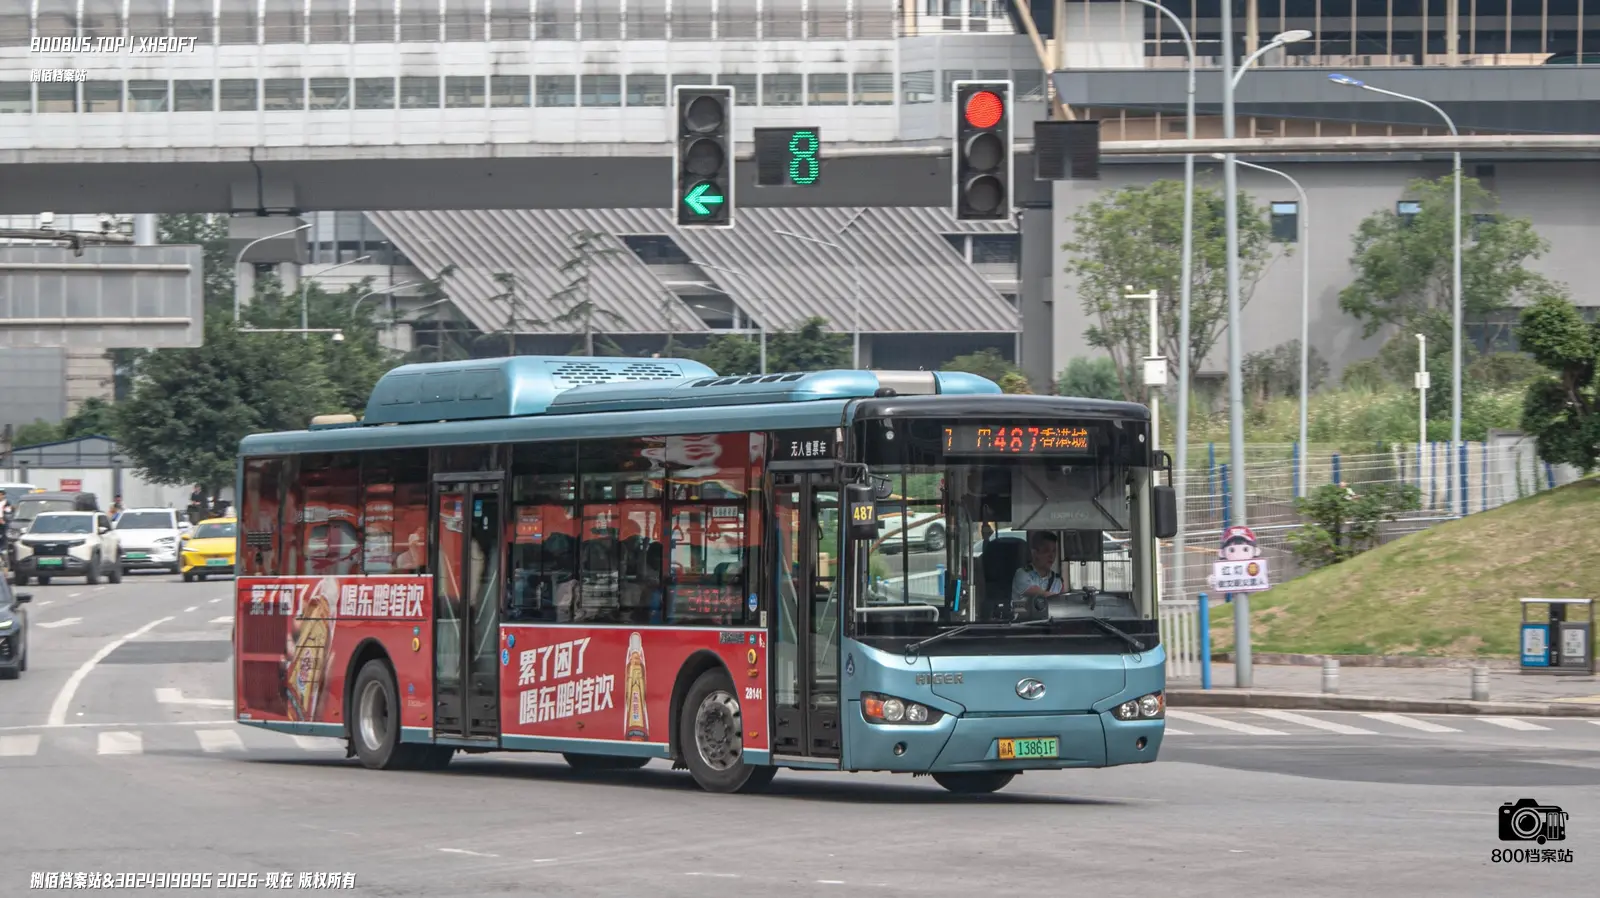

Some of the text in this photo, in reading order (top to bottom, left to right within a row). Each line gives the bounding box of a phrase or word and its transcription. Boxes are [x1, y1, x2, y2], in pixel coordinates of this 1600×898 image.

[789, 131, 819, 184] 8
[790, 440, 827, 457] 无人售票车
[993, 427, 1040, 452] 487
[1040, 427, 1089, 448] 香港城
[853, 505, 873, 521] 487
[250, 584, 311, 616] 累了困了
[339, 583, 425, 617] 喝东鹏特饮
[518, 637, 591, 686] 累了困了
[915, 671, 965, 685] HIGER
[519, 673, 615, 725] 喝东鹏特饮
[745, 687, 762, 700] 28141
[1018, 740, 1055, 755] 13861F
